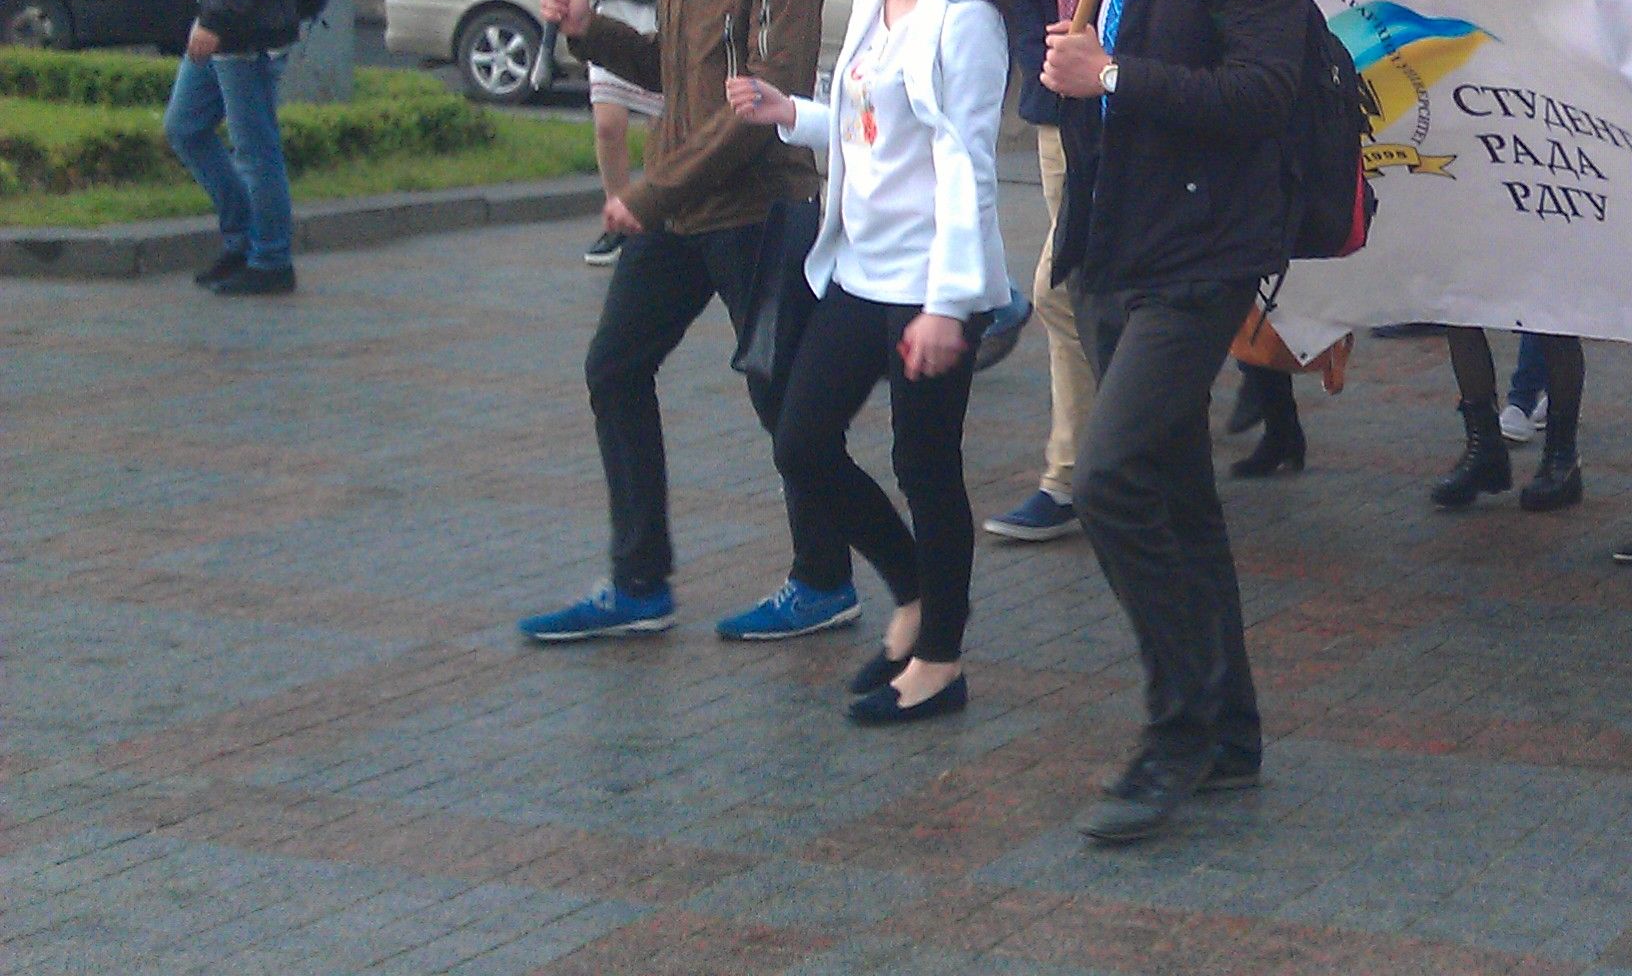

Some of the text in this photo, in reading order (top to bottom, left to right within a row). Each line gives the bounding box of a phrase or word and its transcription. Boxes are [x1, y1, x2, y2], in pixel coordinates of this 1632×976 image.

[1363, 150, 1408, 163] 1998
[1475, 133, 1609, 181] РАДА
[1502, 181, 1607, 223] РДГУ
